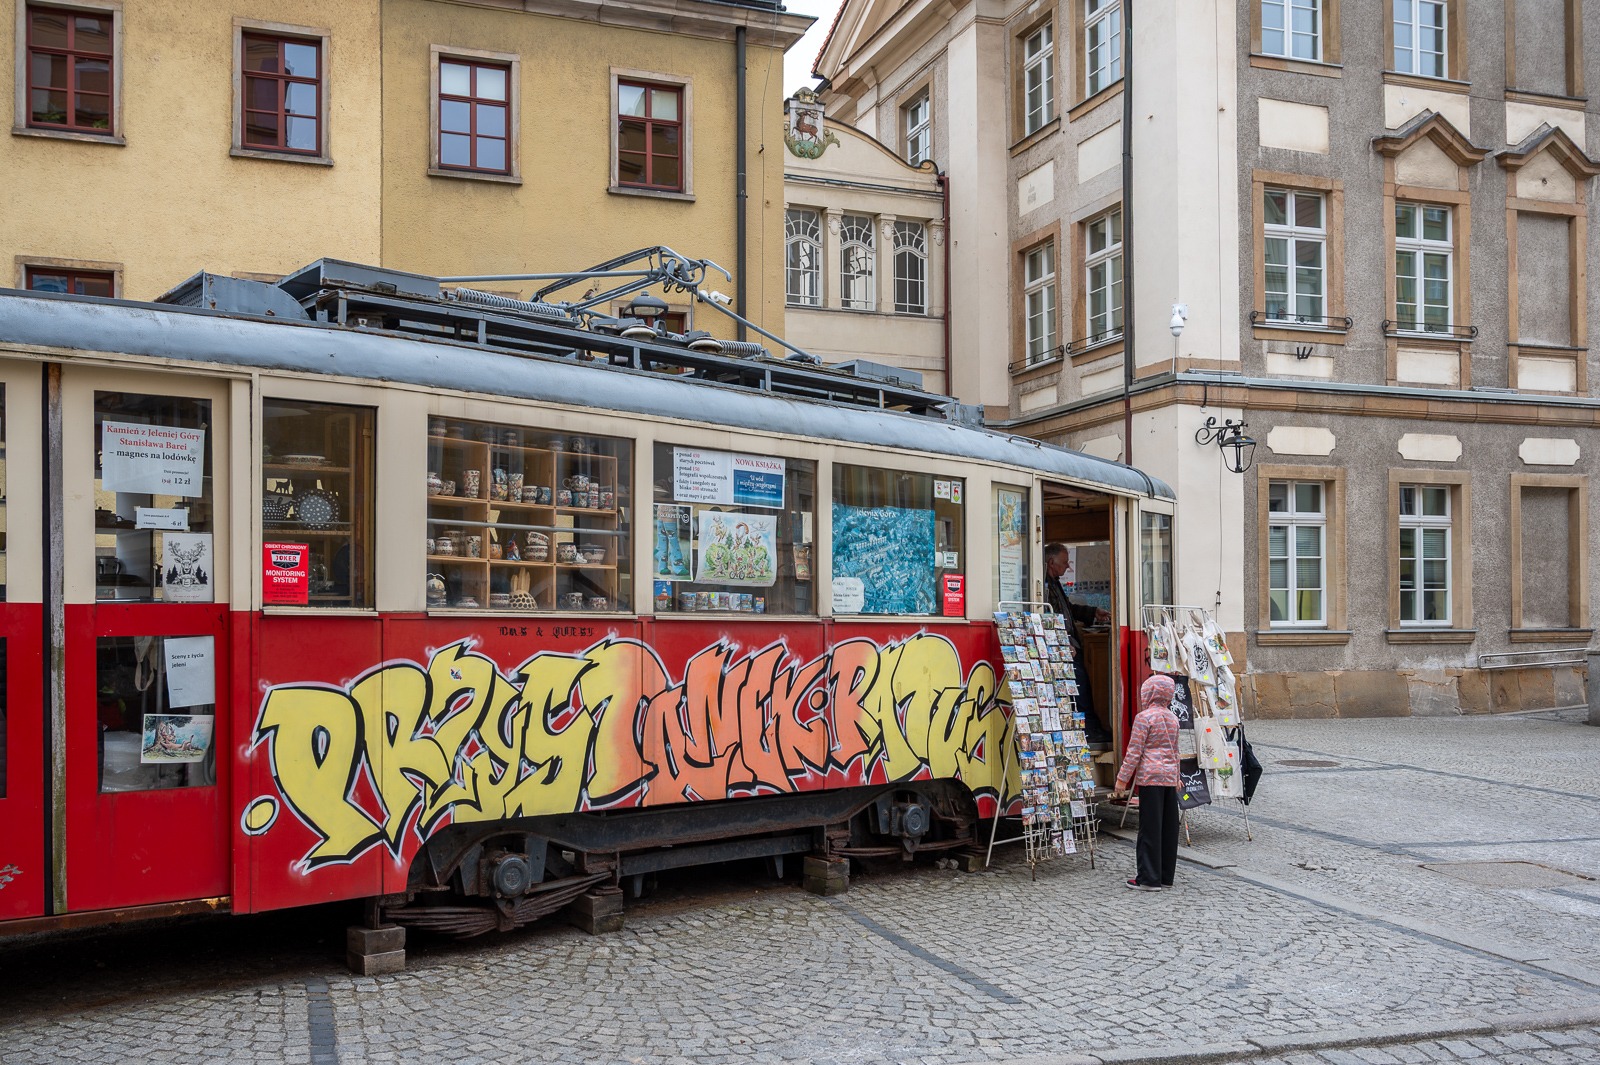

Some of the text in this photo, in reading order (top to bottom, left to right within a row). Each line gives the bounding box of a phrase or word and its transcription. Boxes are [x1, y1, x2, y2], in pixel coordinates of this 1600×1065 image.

[106, 425, 139, 435] Kamień
[148, 429, 178, 439] Jeleniej
[180, 432, 200, 442] Góry
[120, 438, 187, 450] Stanisława Barei
[116, 450, 148, 459] magnes
[162, 452, 196, 464] lodówkę
[735, 459, 782, 470] NOWA KSIĄŻKA
[536, 627, 543, 637] &
